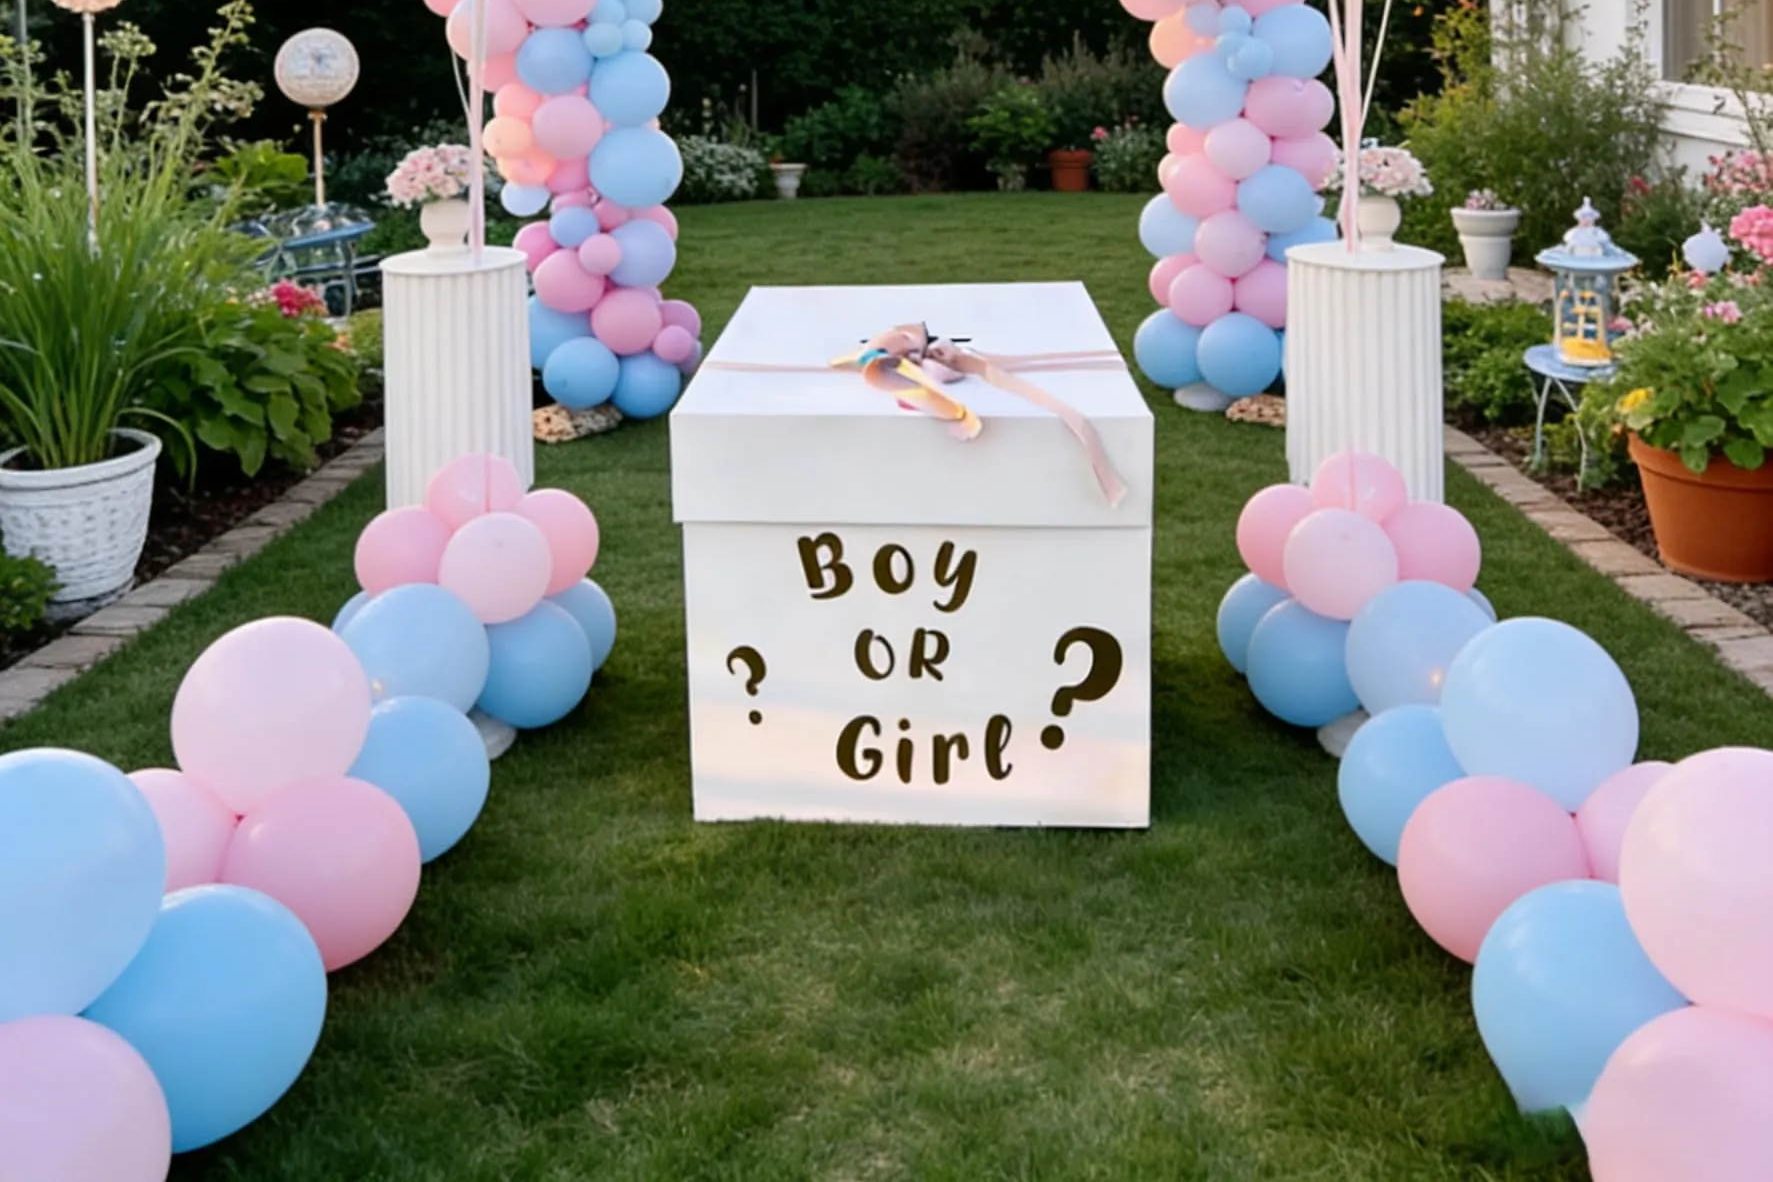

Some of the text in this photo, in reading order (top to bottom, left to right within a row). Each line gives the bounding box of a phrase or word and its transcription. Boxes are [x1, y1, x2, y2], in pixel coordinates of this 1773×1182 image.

[726, 645, 767, 726] ?
[854, 627, 950, 682] OR
[1039, 625, 1124, 751] ?
[835, 714, 1013, 785] Girl
